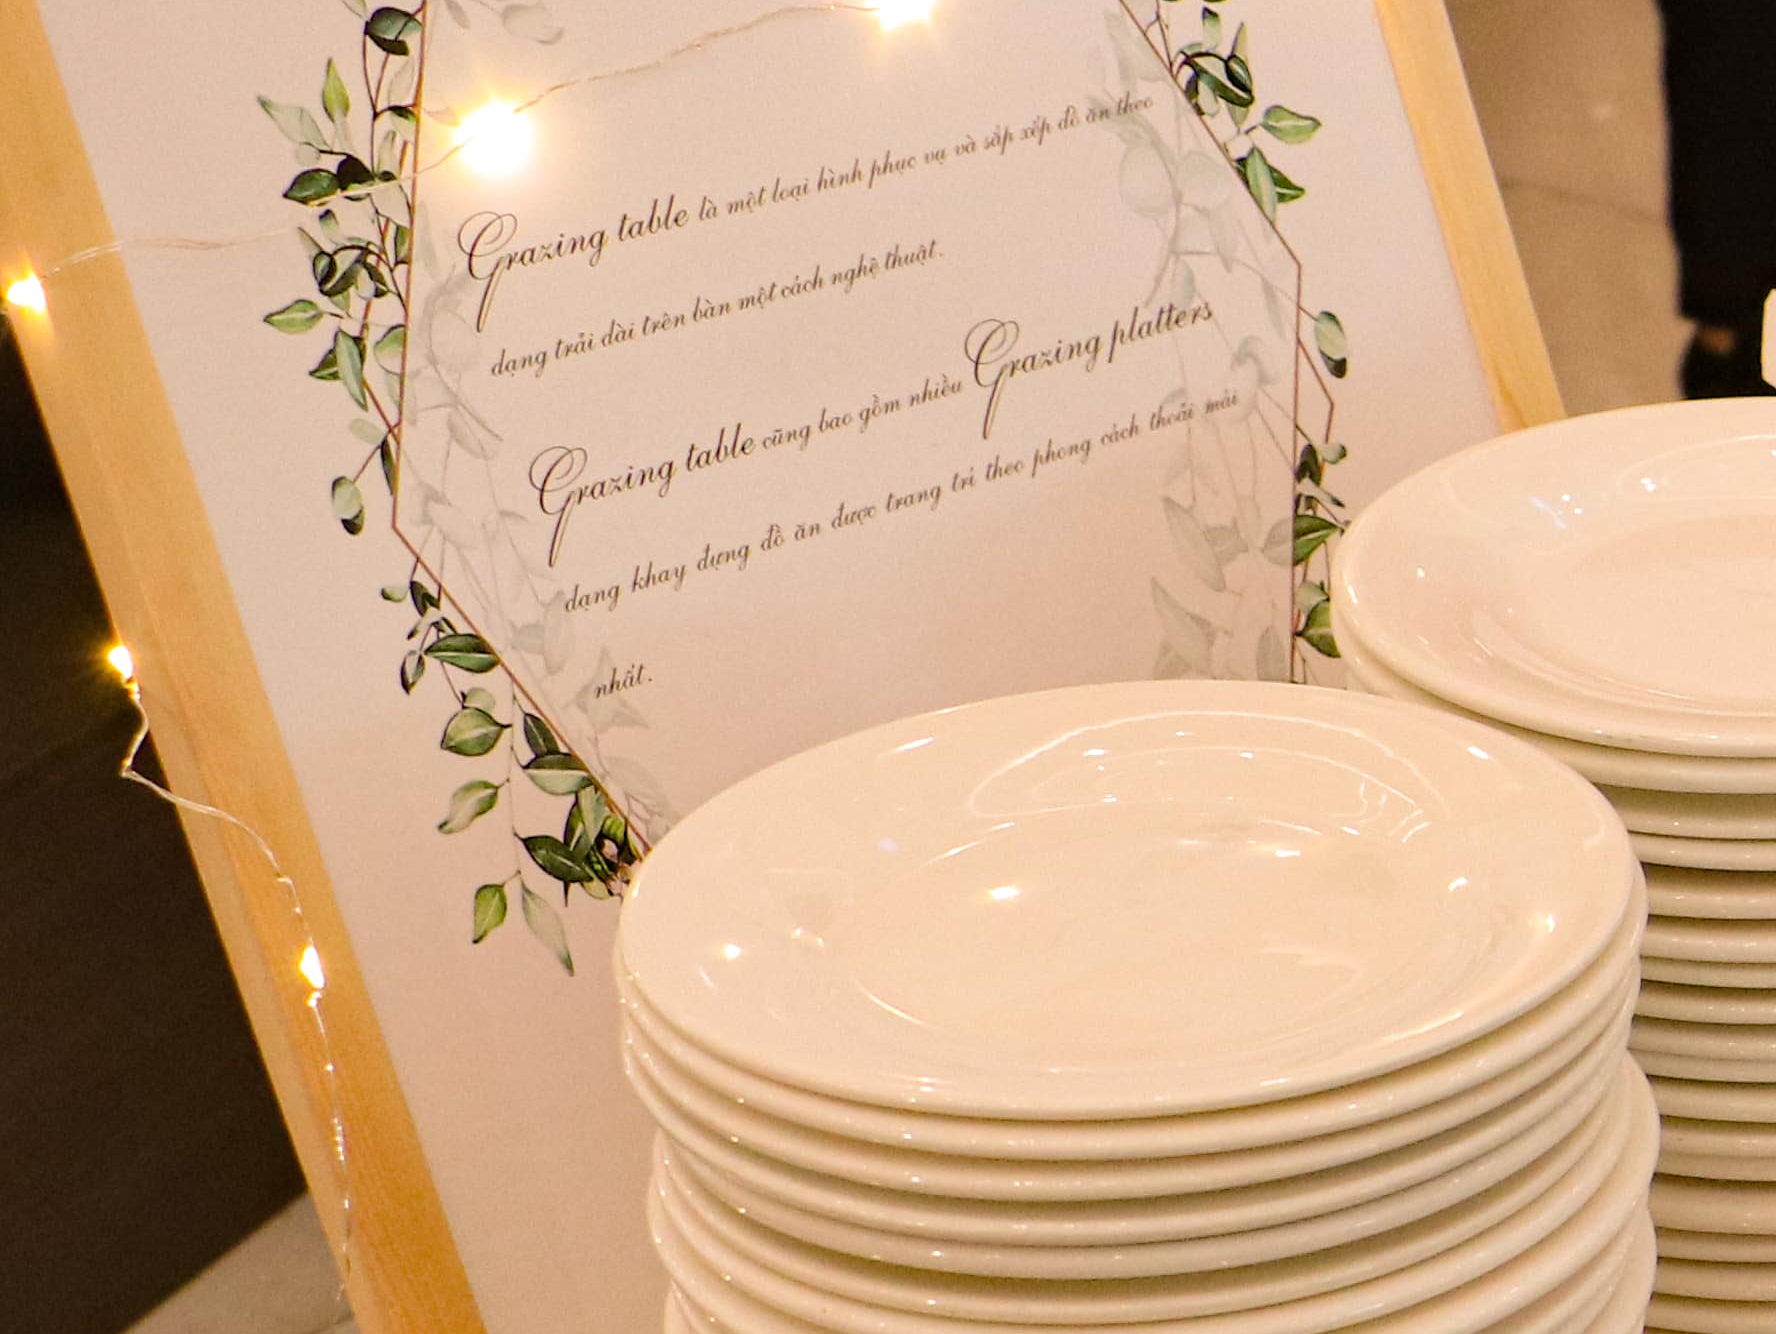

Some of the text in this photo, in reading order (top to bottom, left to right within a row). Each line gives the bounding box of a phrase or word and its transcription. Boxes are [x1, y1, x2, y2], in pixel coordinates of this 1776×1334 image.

[457, 210, 609, 334] Grazing
[617, 194, 691, 241] table
[699, 196, 719, 221] là
[727, 187, 768, 215] một
[772, 177, 811, 203] loại
[816, 158, 864, 193] hình
[867, 150, 919, 190] phục
[923, 148, 947, 165] vụ
[953, 133, 977, 157] và
[1057, 104, 1081, 132] đồ
[1085, 106, 1111, 124] ăn
[1116, 91, 1154, 119] theo
[490, 348, 549, 378] dạng
[553, 331, 596, 360] trải
[600, 319, 636, 348] dài
[641, 313, 686, 336] trên
[692, 296, 732, 324] bàn
[737, 282, 777, 312] một
[781, 265, 825, 298] cách
[831, 253, 880, 294] nghệ
[528, 301, 1214, 568] Grazing table cũng bao gồm nhiều Grazing platters
[564, 584, 621, 613] dạng
[631, 560, 688, 593] khay
[760, 522, 786, 552] đồ
[794, 522, 822, 541] ăn
[830, 501, 877, 530] được
[886, 485, 942, 512] trang
[985, 454, 1025, 481] theo
[1031, 438, 1093, 478] phong
[1099, 414, 1140, 446] cách
[594, 663, 654, 699] nhất.
